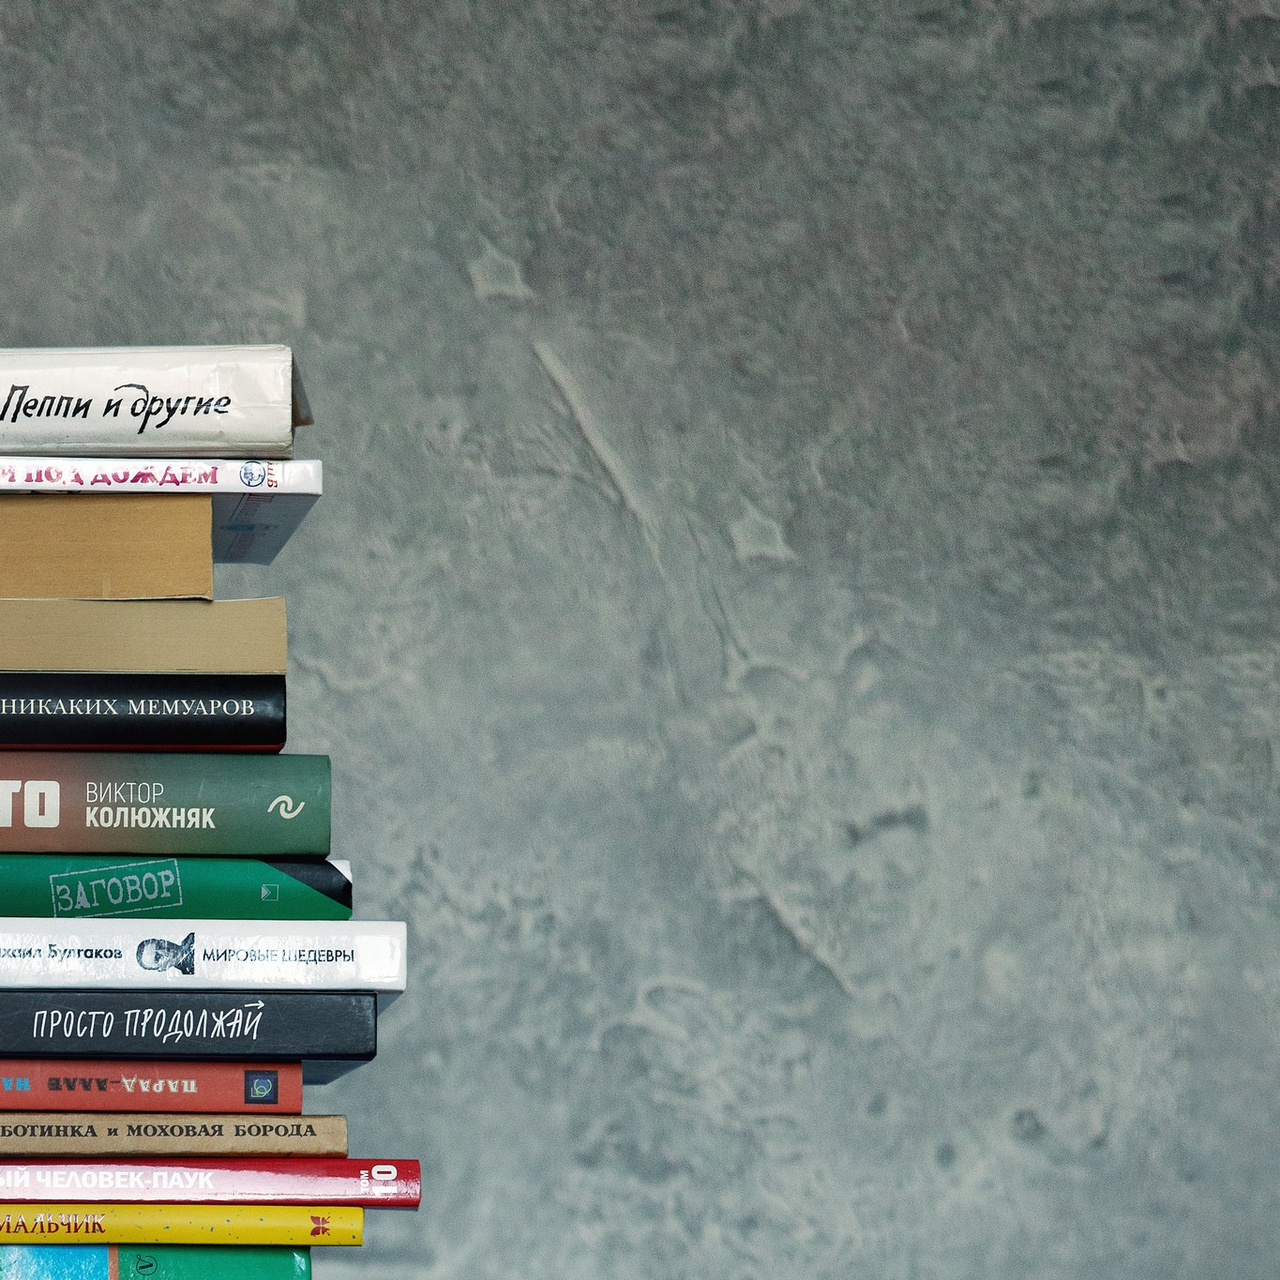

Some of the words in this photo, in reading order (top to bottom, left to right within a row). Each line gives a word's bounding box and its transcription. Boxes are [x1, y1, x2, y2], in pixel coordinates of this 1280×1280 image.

[102, 396, 122, 418] и
[114, 383, 232, 434] другие
[24, 466, 84, 486] ПОД
[0, 698, 119, 716] НИКАКИХ
[127, 698, 256, 716] МЕМУАРОВ
[86, 782, 165, 803] ВИКТОР
[85, 806, 217, 829] КОЛЮЖНЯК
[55, 869, 176, 912] ЗАГОВОР
[48, 942, 124, 961] Булгаков
[202, 949, 278, 963] МИРОВЫЕ
[282, 949, 356, 965] ШЕДЕВРЫ
[33, 1009, 115, 1038] ПРОСТО
[124, 1000, 265, 1044] ПРОДОЛЖАЙ
[126, 1124, 224, 1138] МОХОВАЯ
[234, 1124, 318, 1139] БОРОДА
[36, 1170, 215, 1190] ЧЕЛОВЕК-ПАУК
[360, 1170, 369, 1194] ТОМ
[372, 1165, 398, 1198] 10
